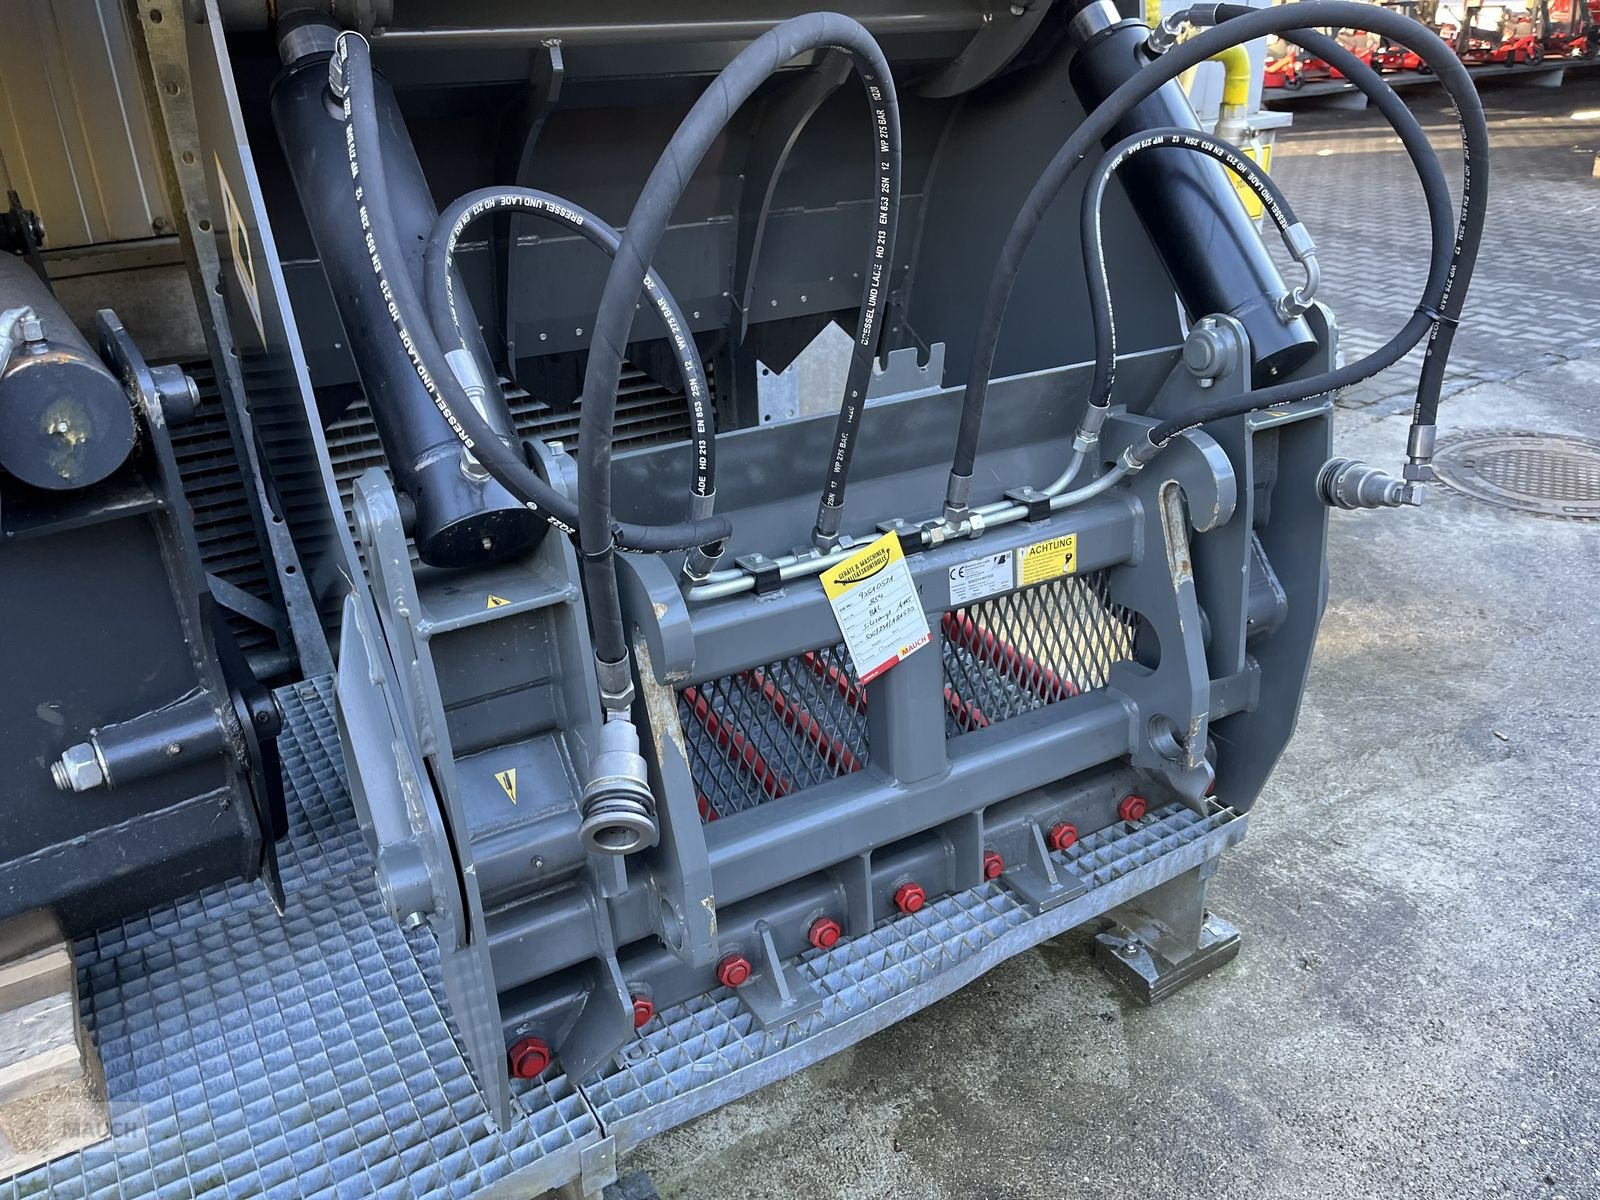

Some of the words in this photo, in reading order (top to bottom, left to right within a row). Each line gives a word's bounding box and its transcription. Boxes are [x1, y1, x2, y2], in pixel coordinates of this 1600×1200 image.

[876, 109, 887, 125] BAR
[879, 125, 888, 139] 275
[1171, 135, 1180, 143] 12
[880, 139, 889, 152] WP
[1127, 141, 1141, 155] BAR
[1141, 139, 1152, 148] 275
[1152, 136, 1164, 145] WP
[1184, 136, 1200, 146] 2SN
[1200, 140, 1213, 151] 853
[1212, 146, 1225, 157] EN
[881, 162, 889, 171] 12
[1225, 154, 1238, 166] 213
[1236, 163, 1248, 174] HD
[881, 177, 889, 194] 2SN
[1246, 172, 1264, 191] LADE
[355, 186, 363, 201] 12
[1260, 190, 1274, 205] UND
[485, 198, 496, 210] HD
[500, 196, 522, 207] LADE
[524, 196, 542, 209] UND
[880, 196, 889, 211] 853
[472, 203, 485, 216] 213
[544, 200, 585, 226] BRESSEL
[1270, 202, 1289, 230] RESSEL
[359, 205, 370, 230] 2SN
[460, 212, 471, 227] EN
[879, 211, 888, 225] EN
[878, 230, 887, 245] 213
[875, 244, 884, 259] HD
[371, 253, 381, 274] EN
[1449, 264, 1457, 278] WP
[643, 273, 656, 290] 2Q
[871, 263, 882, 287] LADE
[380, 279, 393, 302] 213
[1444, 279, 1453, 293] 275
[867, 288, 878, 307] UND
[1439, 293, 1449, 311] BAR
[387, 302, 401, 322] HD
[657, 297, 671, 318] BAR
[667, 317, 680, 334] 275
[860, 309, 875, 346] BRESSEL
[398, 328, 420, 365] LADE
[674, 334, 686, 351] WP
[684, 360, 694, 372] 12
[416, 365, 436, 393] UND
[688, 378, 700, 398] 2SN
[694, 401, 704, 418] 853
[434, 393, 475, 449] BRESSEL
[697, 419, 706, 433] EN
[698, 440, 707, 455] 213
[839, 432, 849, 449] BAR
[836, 449, 845, 461] 275
[698, 456, 707, 470] HD
[833, 461, 842, 473] WP
[697, 476, 706, 497] LADE
[827, 492, 836, 506] 2SN
[547, 515, 576, 534] 2Q22
[1029, 537, 1073, 556] ACHTUNG
[838, 566, 856, 580] GERÄTE
[855, 563, 860, 572] &
[860, 547, 886, 567] MASCHINEN
[901, 636, 927, 656] MAUCH
